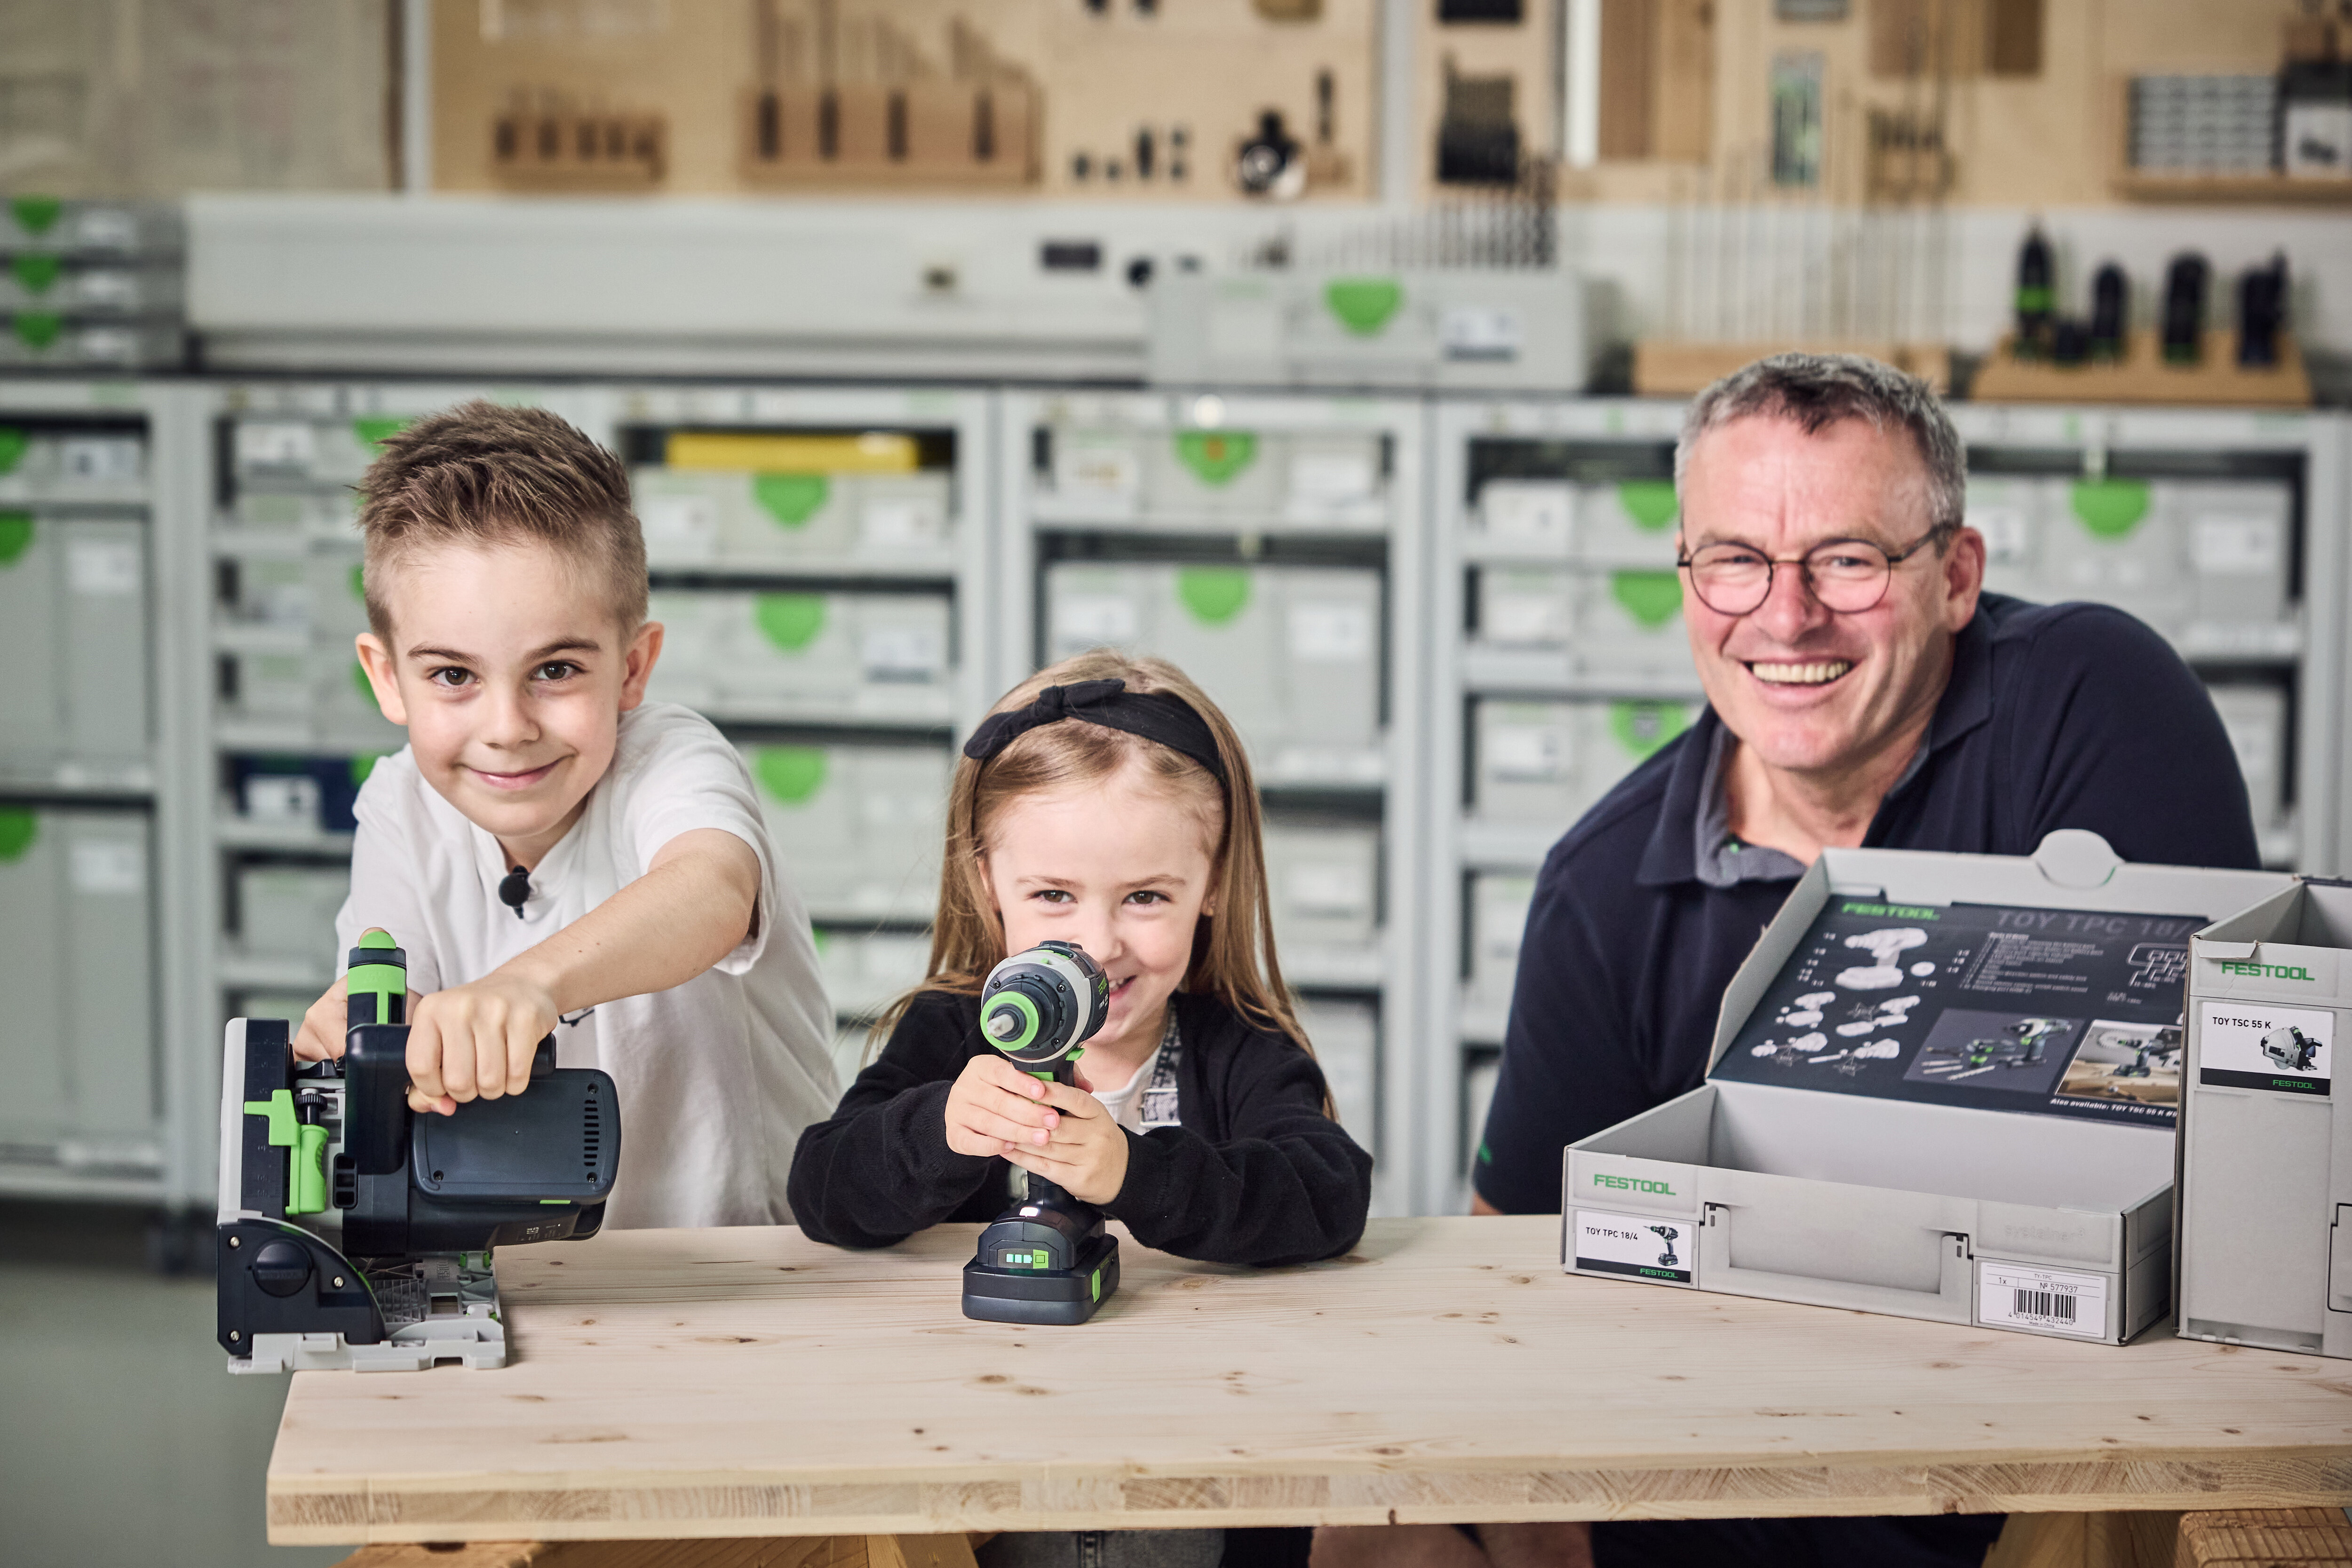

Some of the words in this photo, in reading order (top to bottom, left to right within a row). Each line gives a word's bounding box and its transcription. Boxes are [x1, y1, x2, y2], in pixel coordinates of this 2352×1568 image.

[1997, 910, 2058, 930] TOY
[2068, 913, 2128, 935] TPC
[2141, 919, 2200, 938] 18/
[2221, 961, 2315, 981] FESTOOL
[2212, 1017, 2230, 1026] TOY
[2232, 1019, 2249, 1027] TSC
[2273, 1079, 2316, 1089] FESTOOL
[1594, 1174, 1677, 1196] FESTOOL
[1586, 1227, 1601, 1235] TOY
[1603, 1229, 1619, 1238] TPC
[1621, 1232, 1638, 1240] 18/4
[1640, 1268, 1678, 1279] FESTOOL
[2050, 1283, 2078, 1293] 577937
